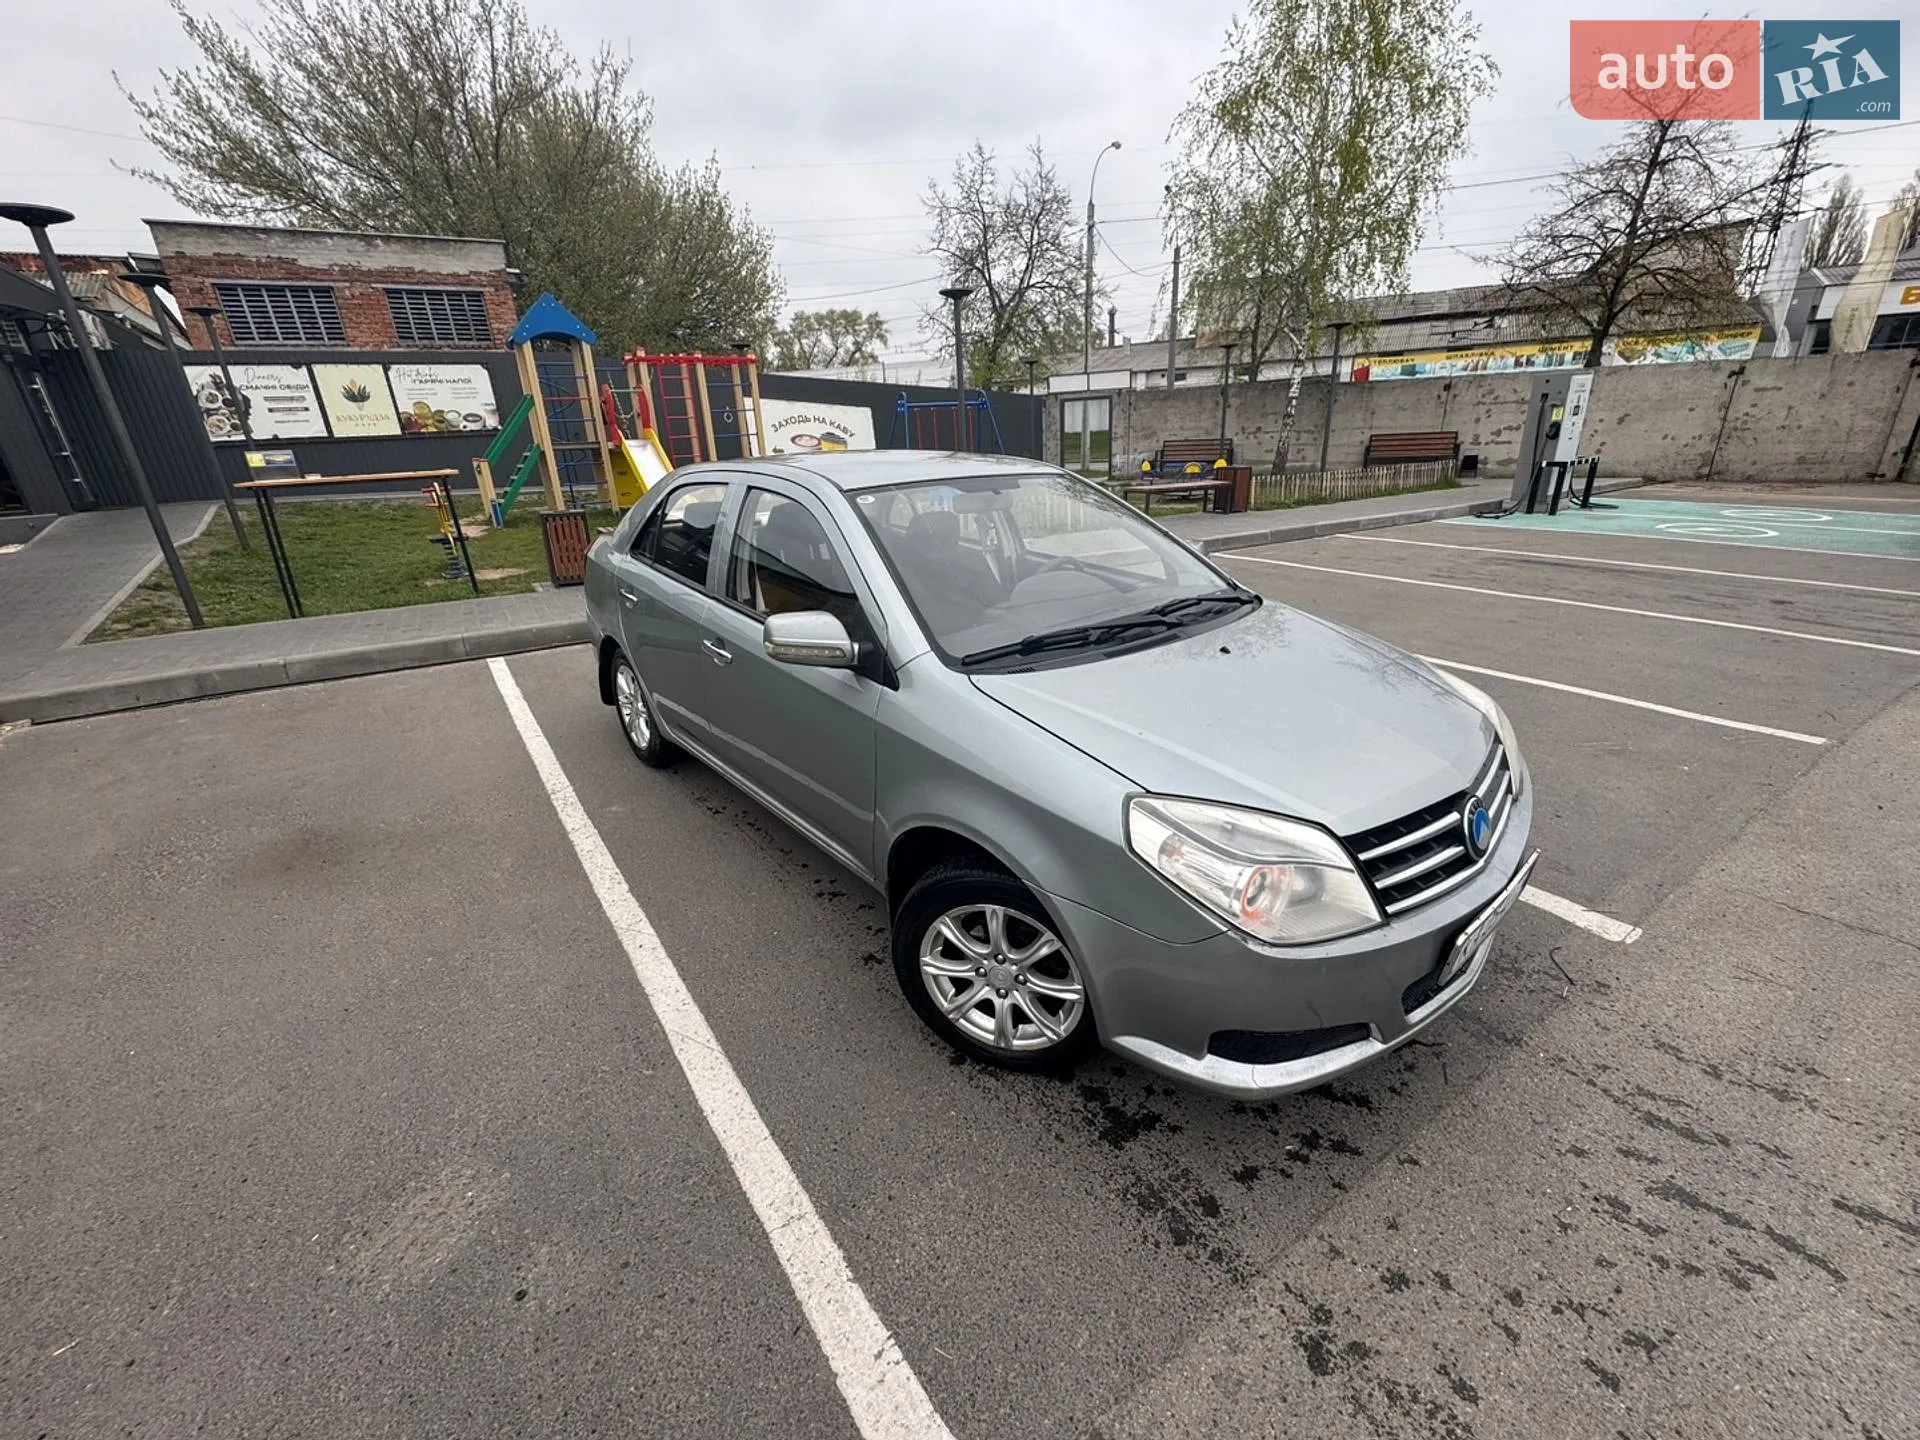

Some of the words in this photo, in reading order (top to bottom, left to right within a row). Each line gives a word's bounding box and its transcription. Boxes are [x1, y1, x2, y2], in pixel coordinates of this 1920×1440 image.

[771, 415, 812, 433] ЗАХОДЬ
[813, 415, 828, 426] НА
[829, 421, 856, 438] КАВУ
